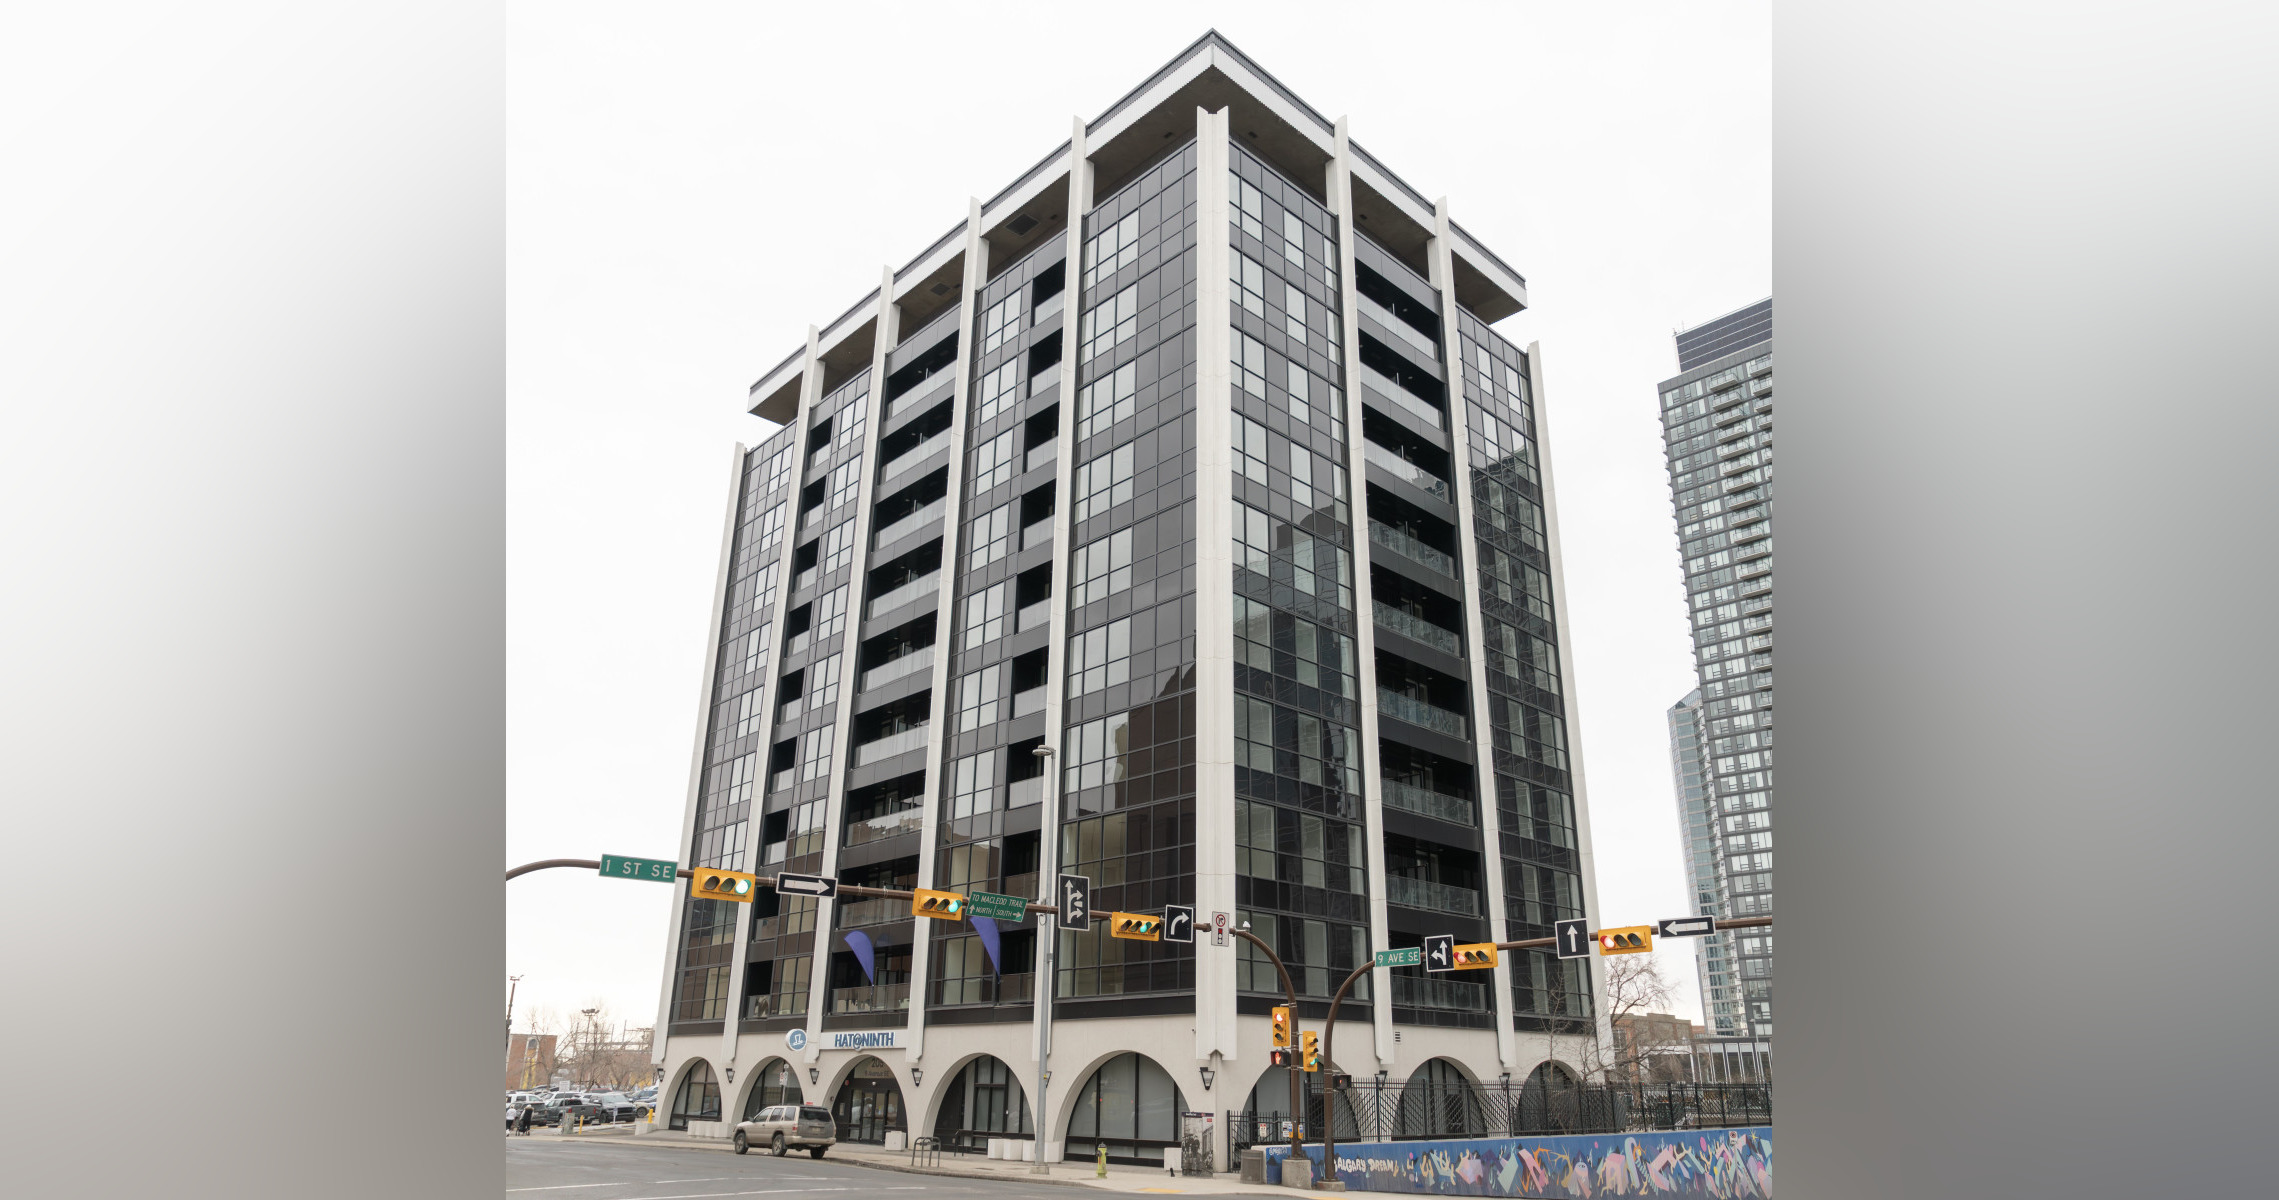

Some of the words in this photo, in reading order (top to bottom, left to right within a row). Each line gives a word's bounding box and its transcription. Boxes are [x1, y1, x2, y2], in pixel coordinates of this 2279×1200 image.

[622, 861, 643, 876] ST
[651, 864, 672, 879] SE
[972, 893, 980, 902] TO
[980, 895, 1007, 906] MACLEOD
[1008, 898, 1024, 908] TRAIL
[975, 906, 992, 915] NORTH
[996, 909, 1013, 917] SOUTH
[1377, 954, 1384, 964] 9
[1387, 952, 1405, 963] AVE
[1408, 951, 1419, 962] SE
[834, 1031, 895, 1050] HAT@NINTH
